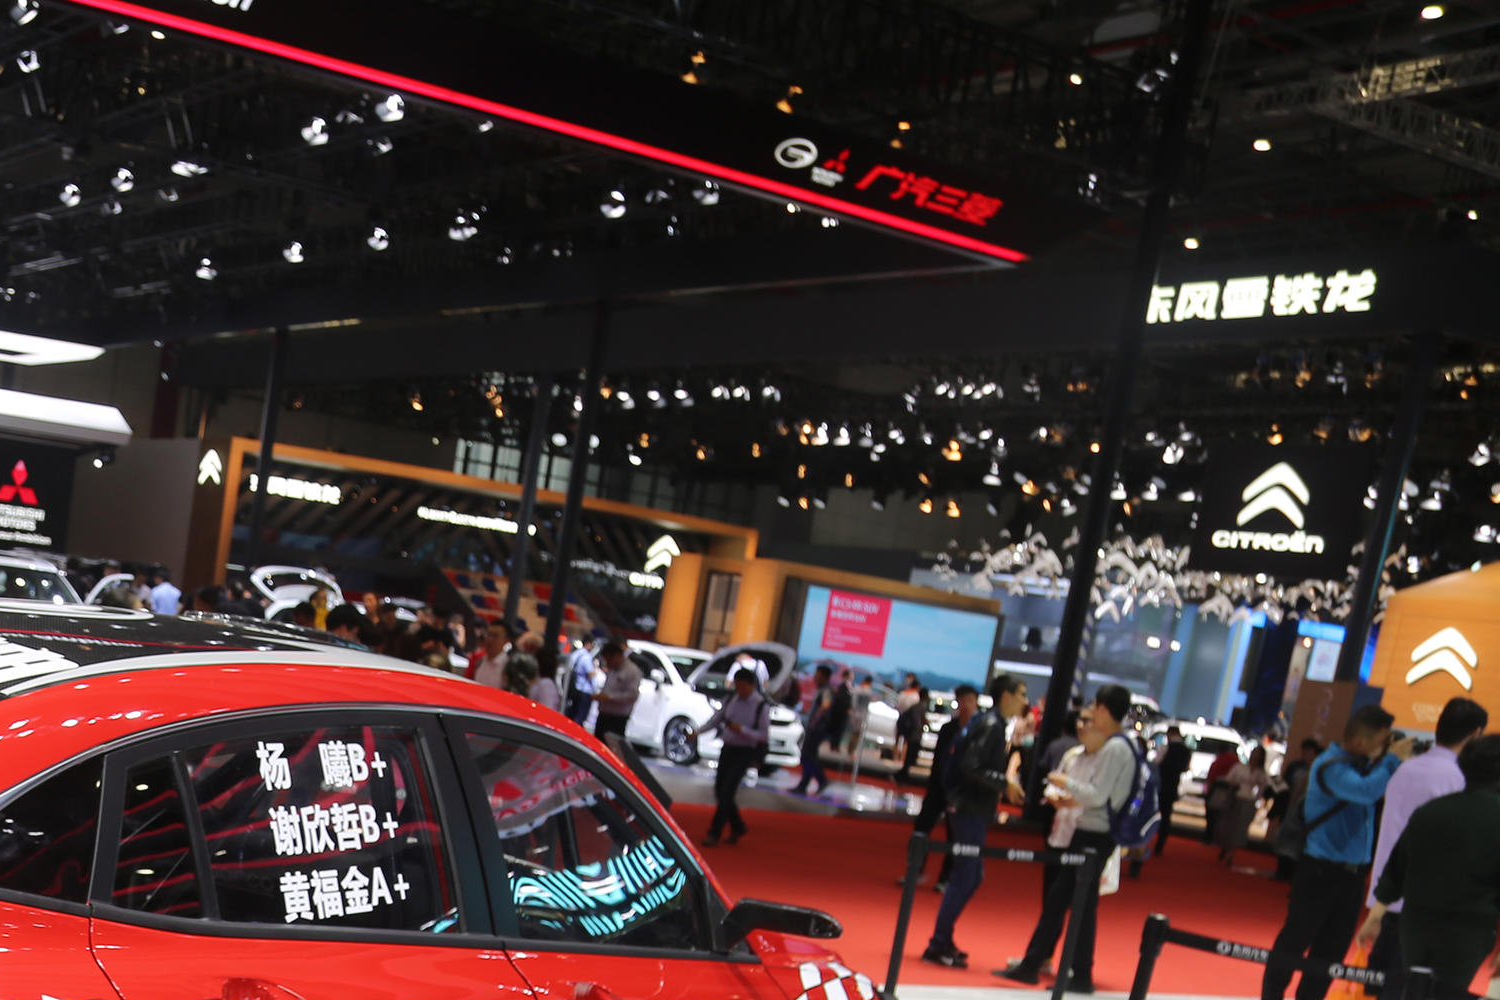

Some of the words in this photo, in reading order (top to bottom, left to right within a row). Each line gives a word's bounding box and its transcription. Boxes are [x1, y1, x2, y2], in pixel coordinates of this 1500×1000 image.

[256, 741, 291, 792] 杨
[269, 802, 399, 856] 谢欣哲B+
[279, 865, 410, 923] 黄福金A+
